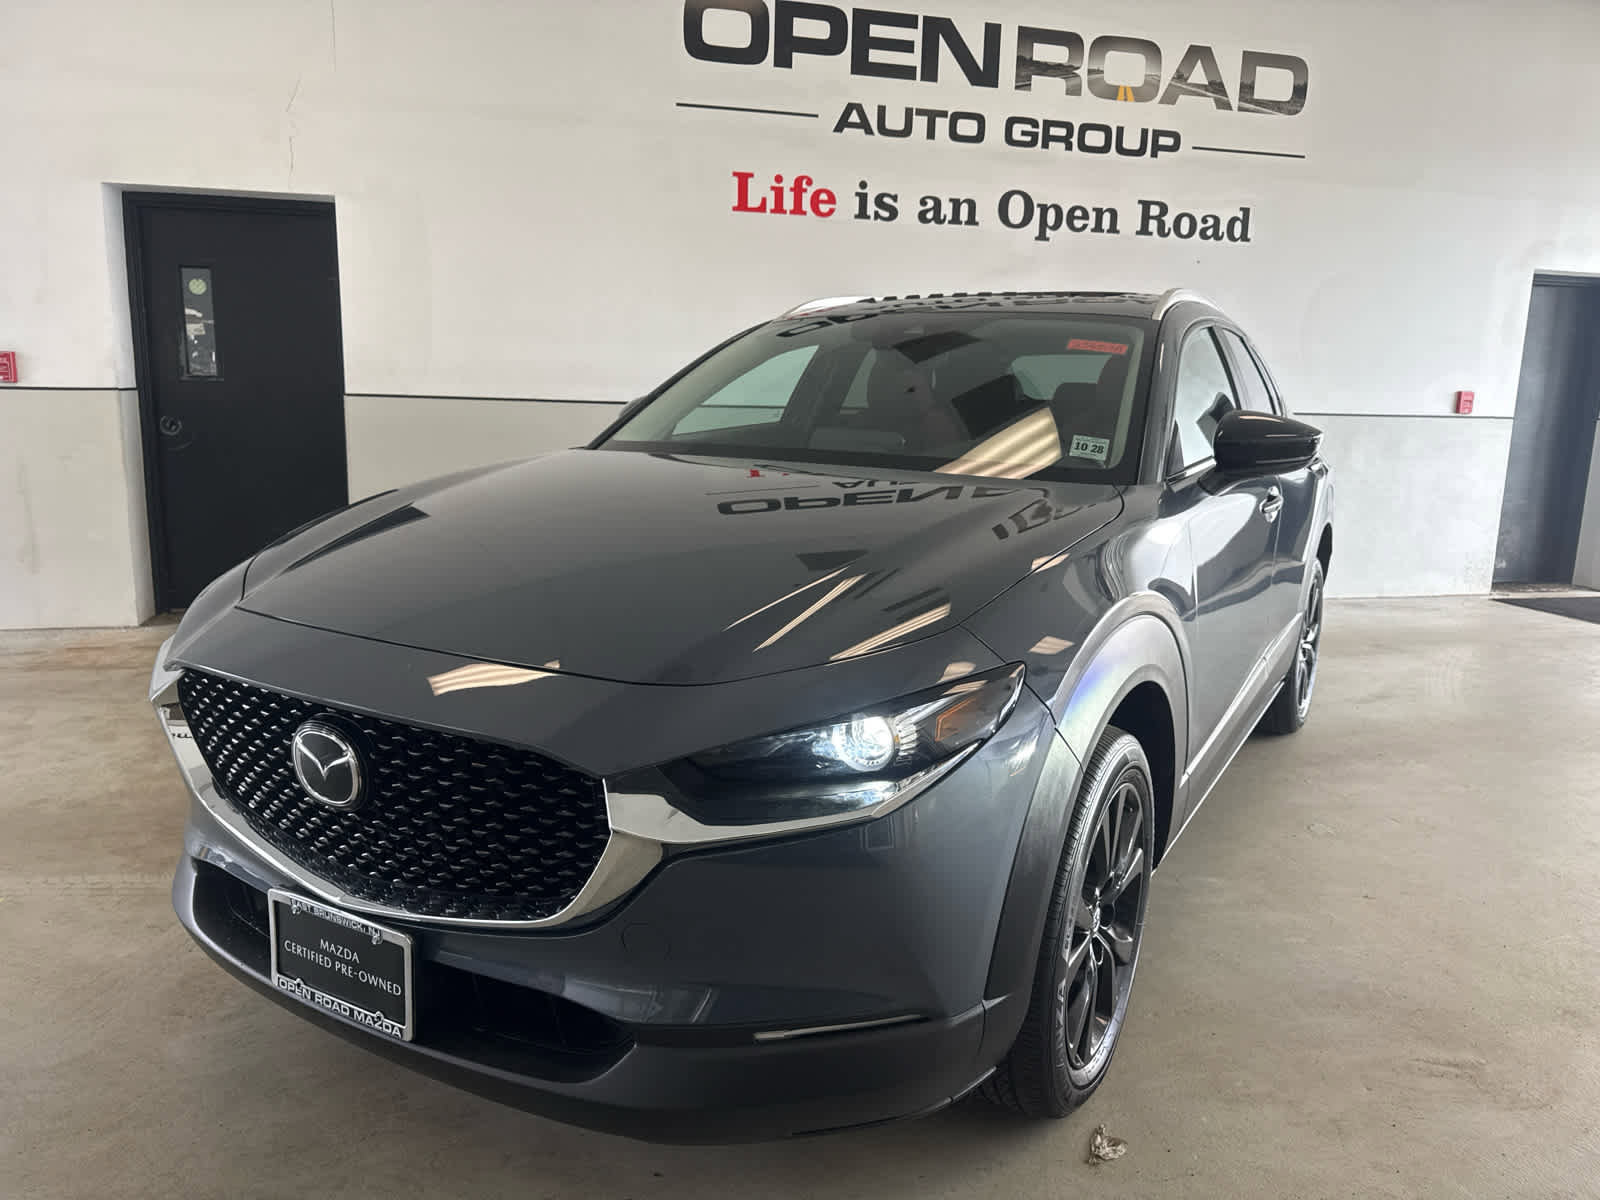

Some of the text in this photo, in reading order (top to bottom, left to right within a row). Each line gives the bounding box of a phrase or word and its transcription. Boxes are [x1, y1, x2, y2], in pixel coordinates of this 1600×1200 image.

[684, 0, 1309, 116] OPEN ROAD
[833, 102, 1182, 159] AUTO GROUP
[732, 171, 1252, 243] Life is an Open Road
[1074, 441, 1105, 454] 10 28
[284, 940, 402, 996] CERTIFIED PRE-OWNED
[320, 938, 360, 964] MAZDA
[279, 977, 402, 1039] OPEN ROAD MAZDA
